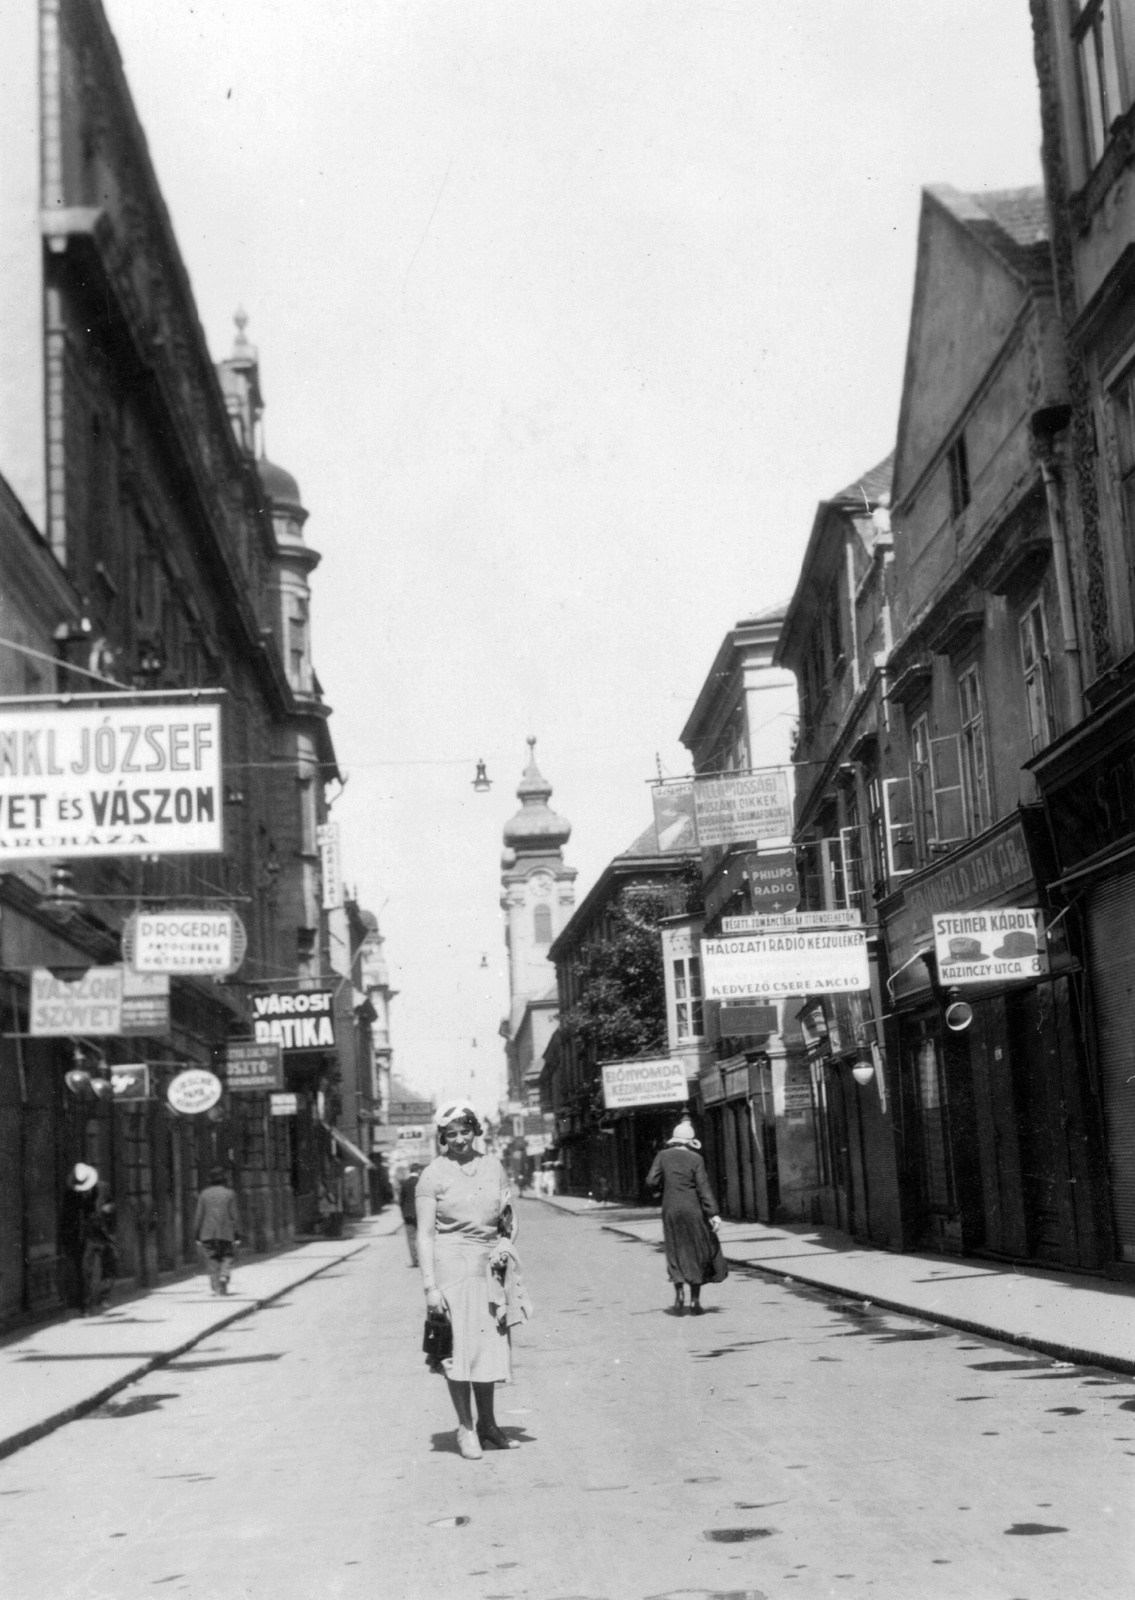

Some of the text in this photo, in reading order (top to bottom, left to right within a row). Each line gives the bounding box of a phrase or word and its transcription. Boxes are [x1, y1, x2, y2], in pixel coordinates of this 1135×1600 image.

[71, 716, 213, 774] JÓZSEF
[0, 780, 215, 829] ET ÉS VÁSZON
[739, 794, 778, 810] CIKKEK
[752, 868, 793, 881] PHILIPS
[754, 883, 795, 896] RADIO
[142, 922, 227, 937] DROGERIA
[937, 911, 1040, 935] STEINER KÁROLY
[773, 979, 810, 991] CSERE
[815, 976, 859, 988] AKCIÓ
